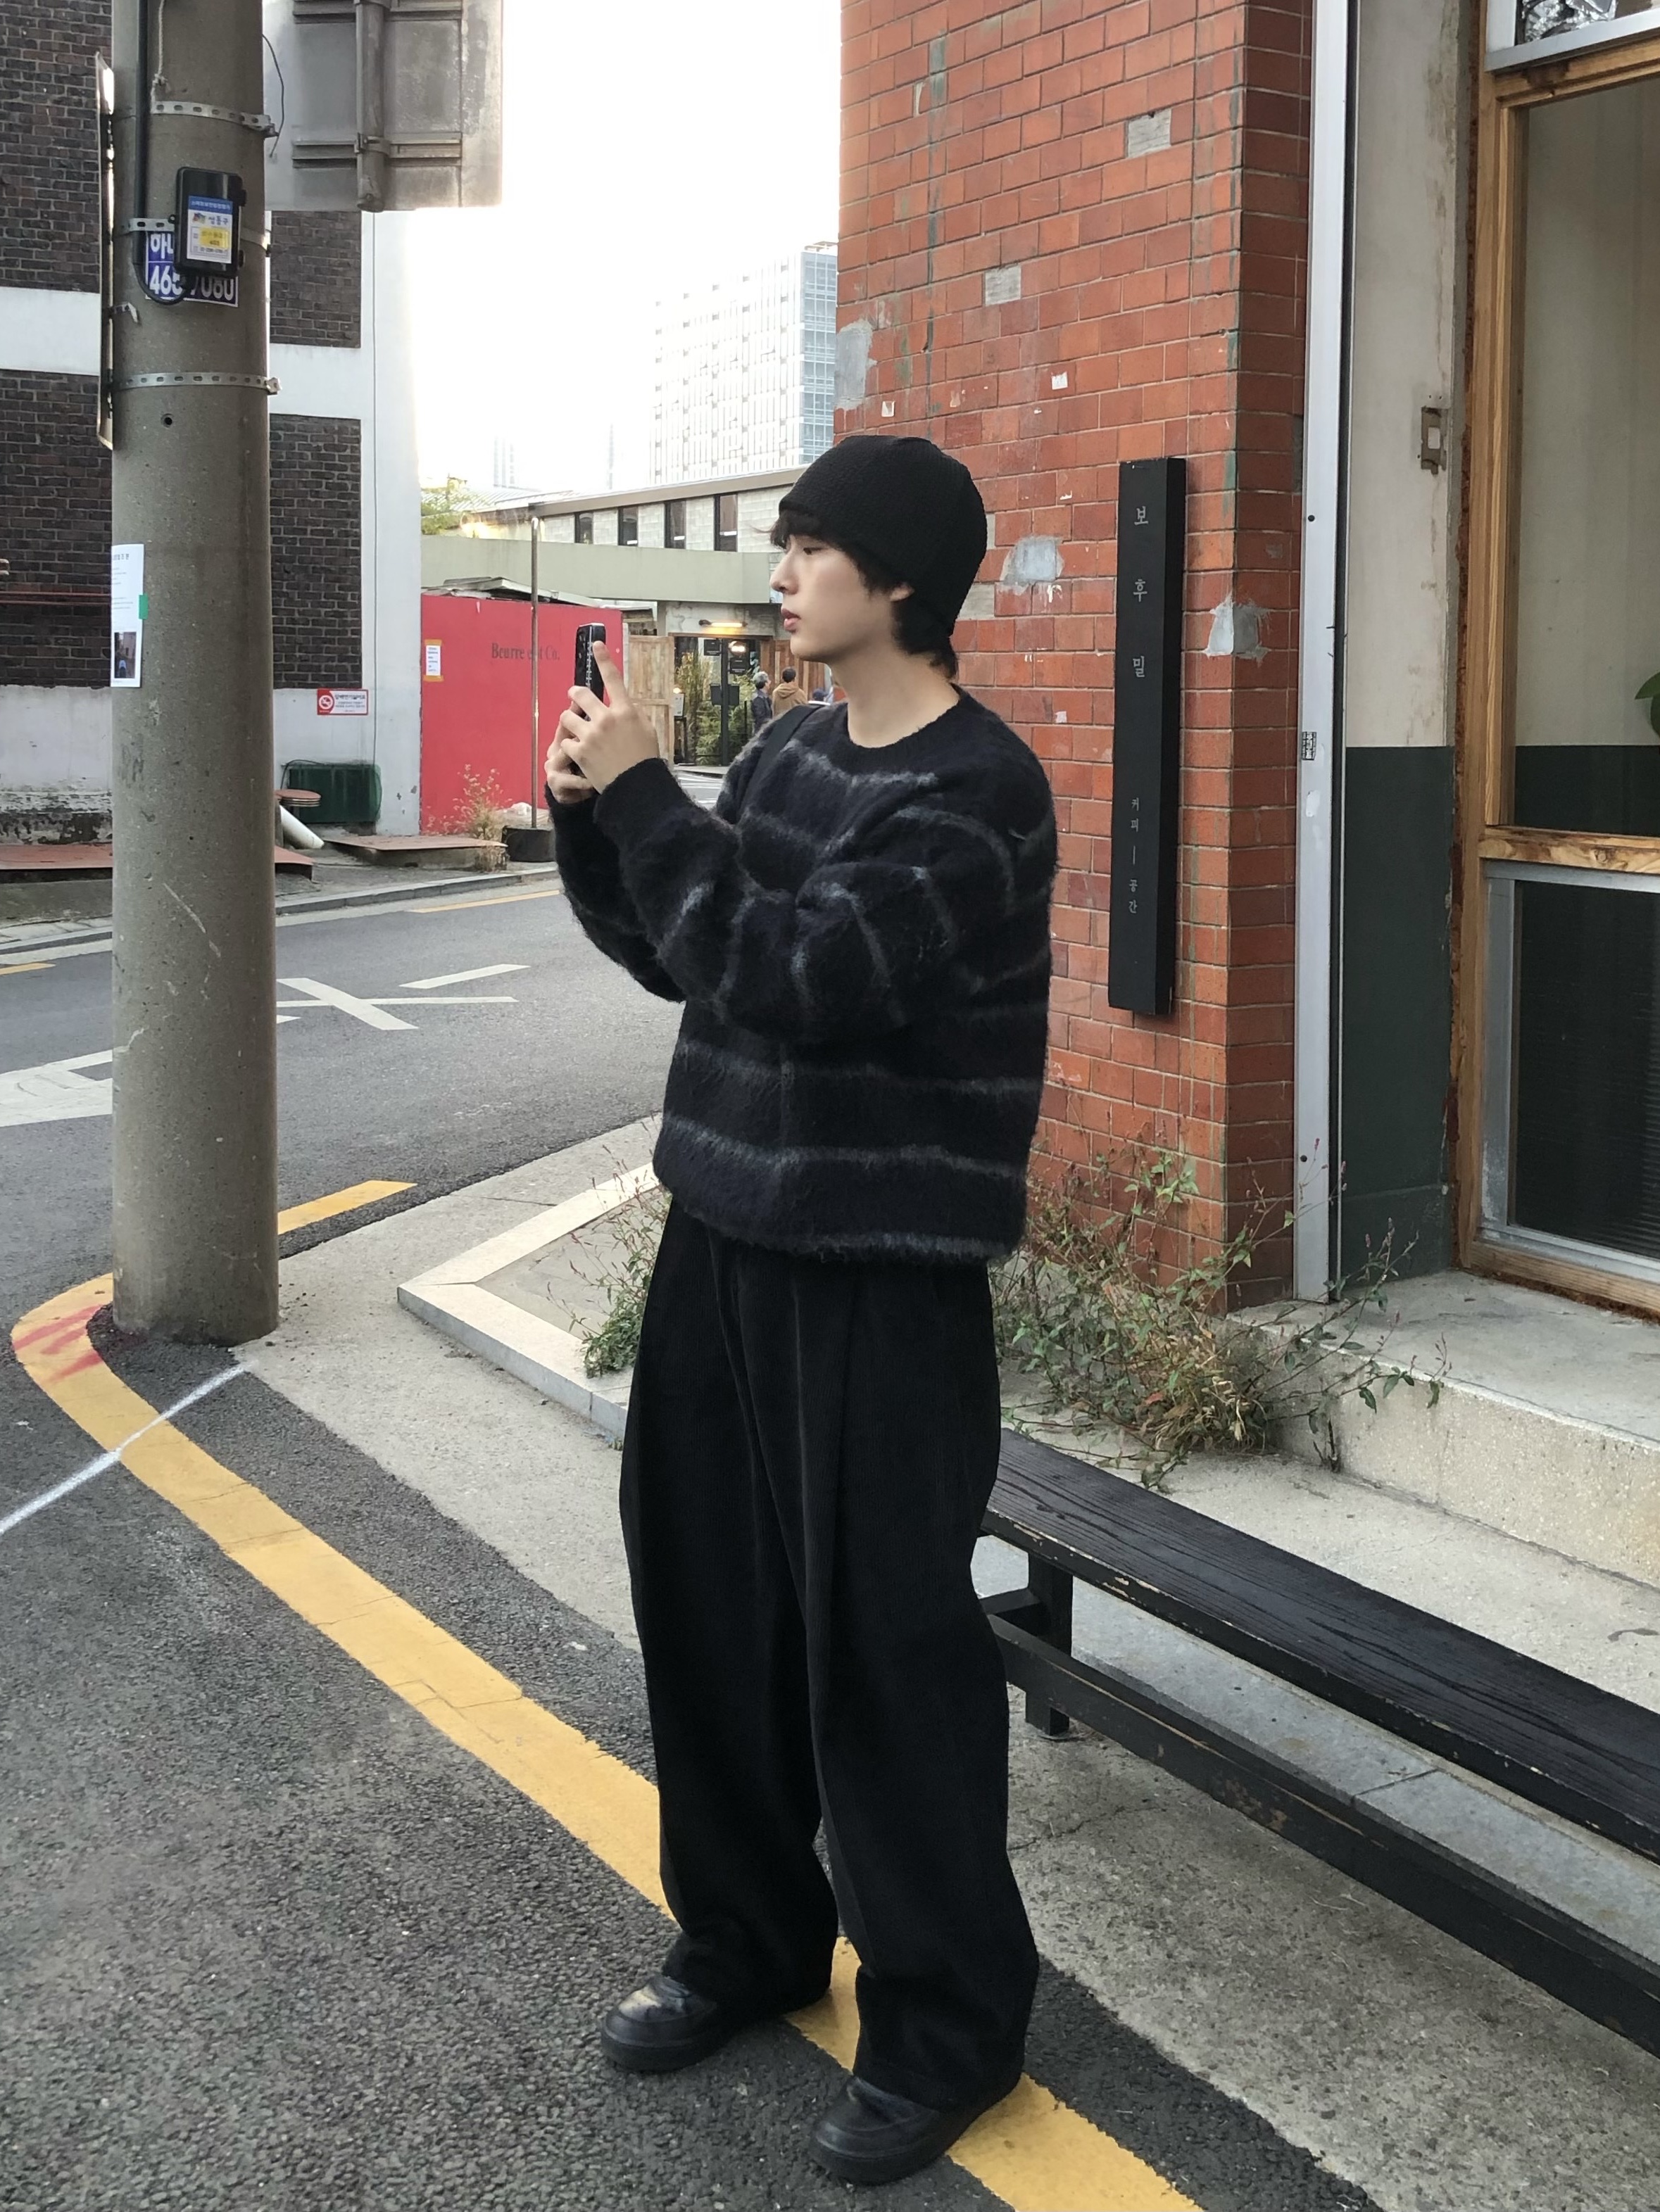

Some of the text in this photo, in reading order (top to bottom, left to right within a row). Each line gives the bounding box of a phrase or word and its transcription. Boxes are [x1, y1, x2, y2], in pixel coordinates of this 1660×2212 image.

[491, 643, 525, 659] Beurre
[1128, 797, 1140, 914] 커피 공간
